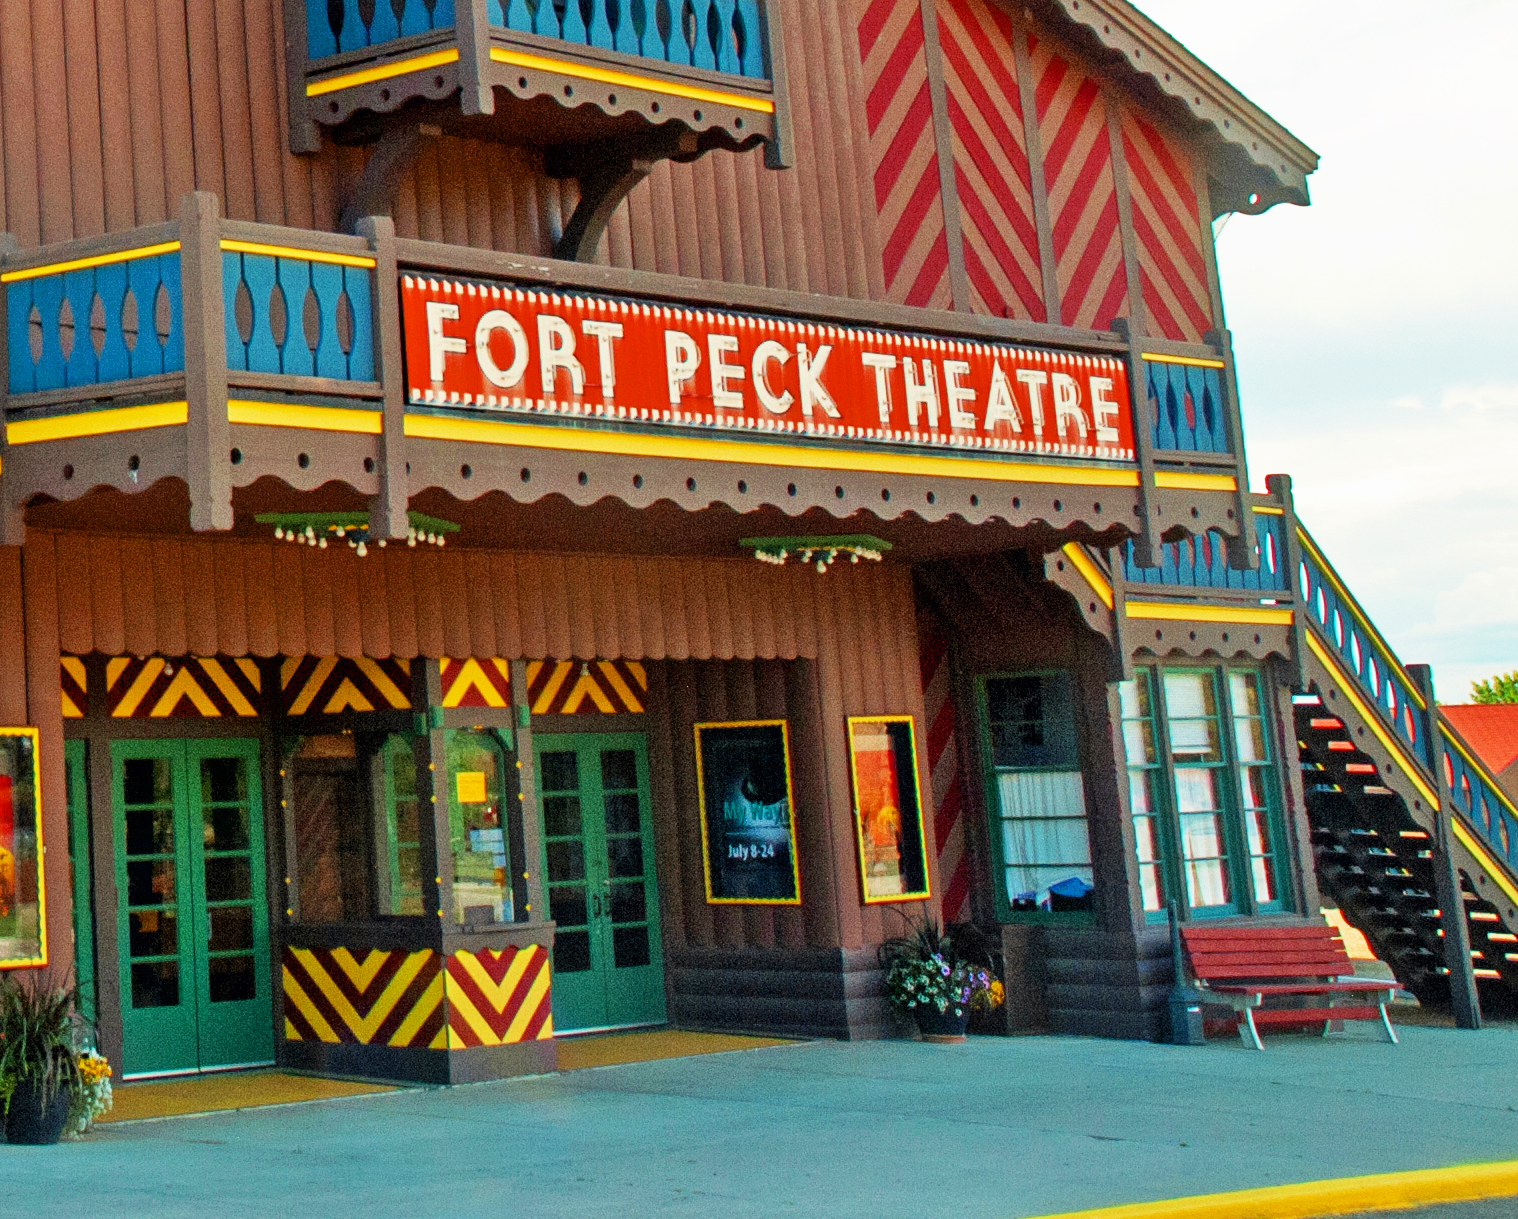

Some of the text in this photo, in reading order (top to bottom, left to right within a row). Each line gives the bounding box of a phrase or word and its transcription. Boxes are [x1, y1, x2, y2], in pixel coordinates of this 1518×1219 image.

[425, 301, 1120, 442] FORT PECK THEATRE
[728, 843, 774, 861] July 8-24
